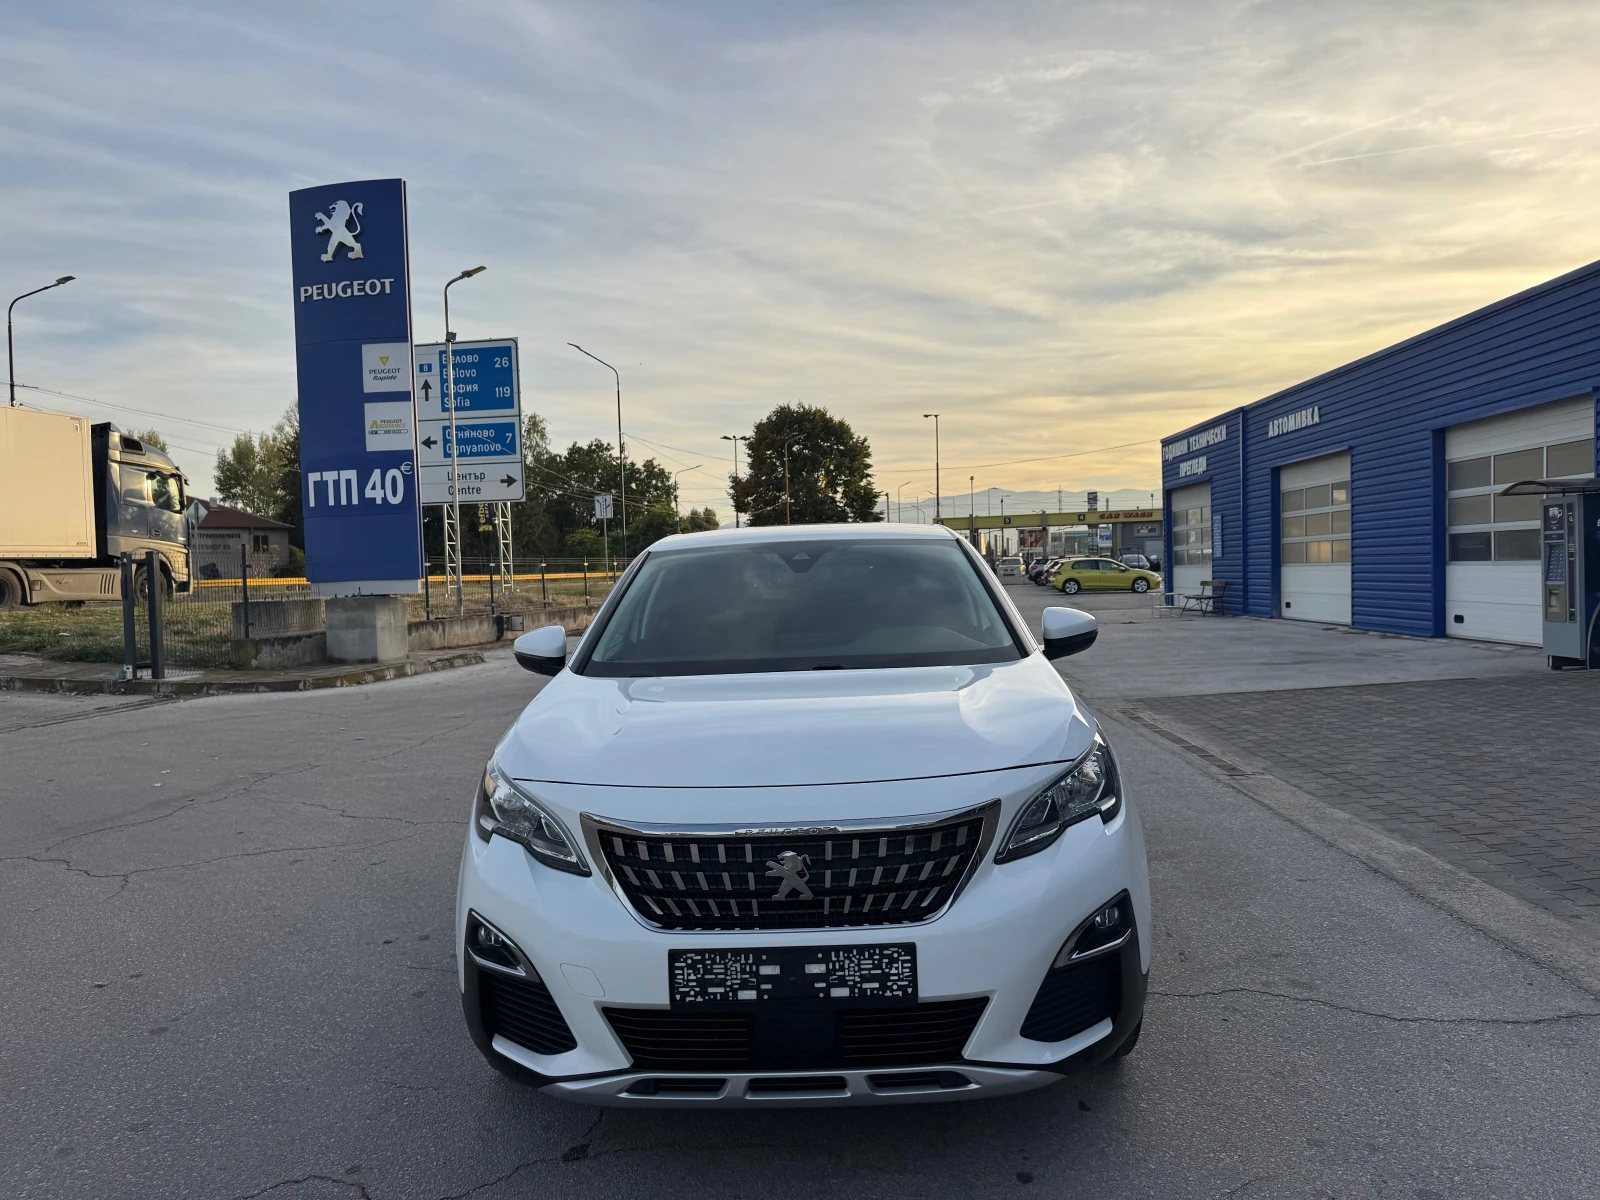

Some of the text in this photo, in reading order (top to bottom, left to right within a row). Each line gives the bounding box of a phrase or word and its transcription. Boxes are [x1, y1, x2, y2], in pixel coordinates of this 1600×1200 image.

[300, 278, 395, 303] PEUGEOT
[494, 357, 510, 368] 26
[495, 387, 511, 398] 119
[1268, 405, 1320, 438] АВТОМИВКА
[505, 433, 513, 444] 7
[1189, 424, 1227, 451] ТЕХНИЧЕСКИ
[1179, 455, 1207, 477] ПРЕГЛЕДИ
[307, 469, 359, 508] ГТП
[1123, 511, 1153, 519] WASH
[745, 826, 831, 836] PEUGEOT
